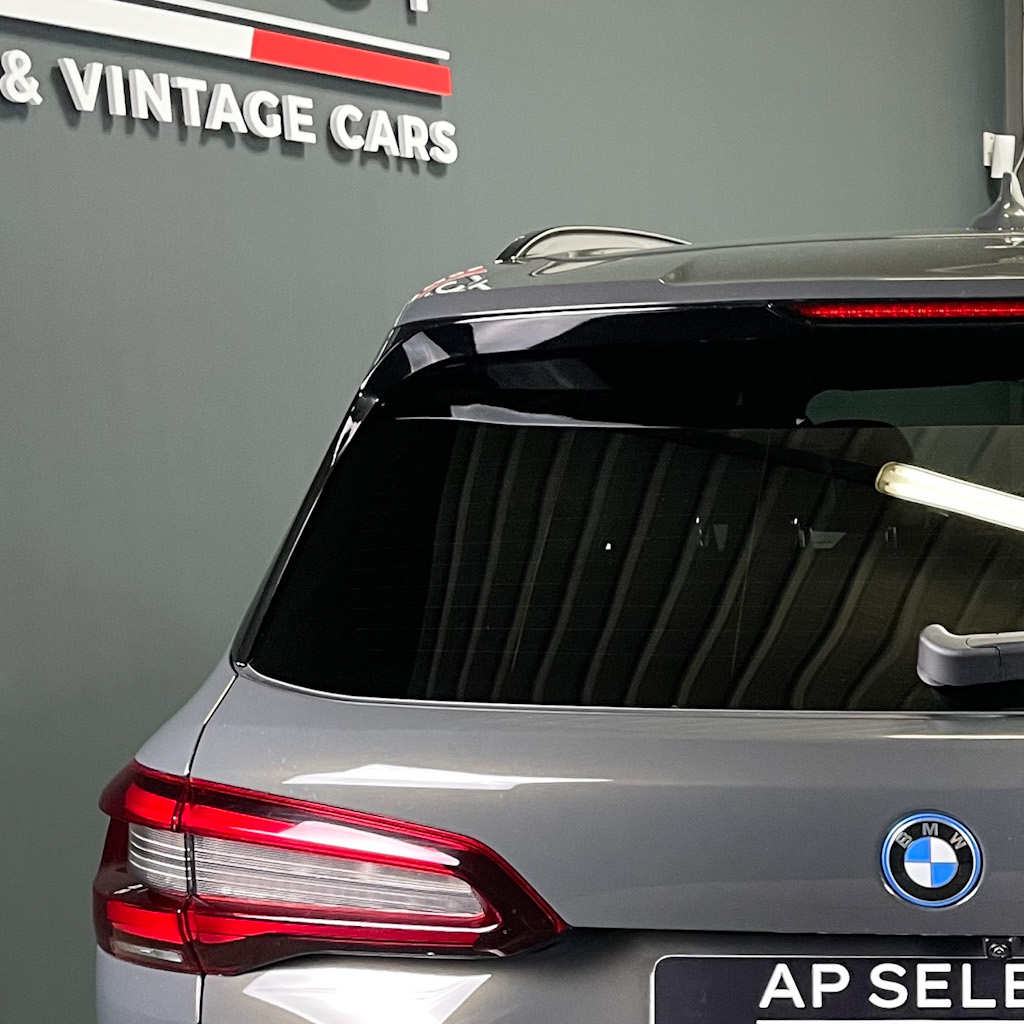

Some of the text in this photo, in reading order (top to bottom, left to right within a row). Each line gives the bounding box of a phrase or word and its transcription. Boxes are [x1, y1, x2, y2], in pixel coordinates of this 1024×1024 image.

[0, 49, 458, 164] & VINTAGE CARS
[896, 822, 967, 850] BMW
[759, 963, 850, 1008] AP
